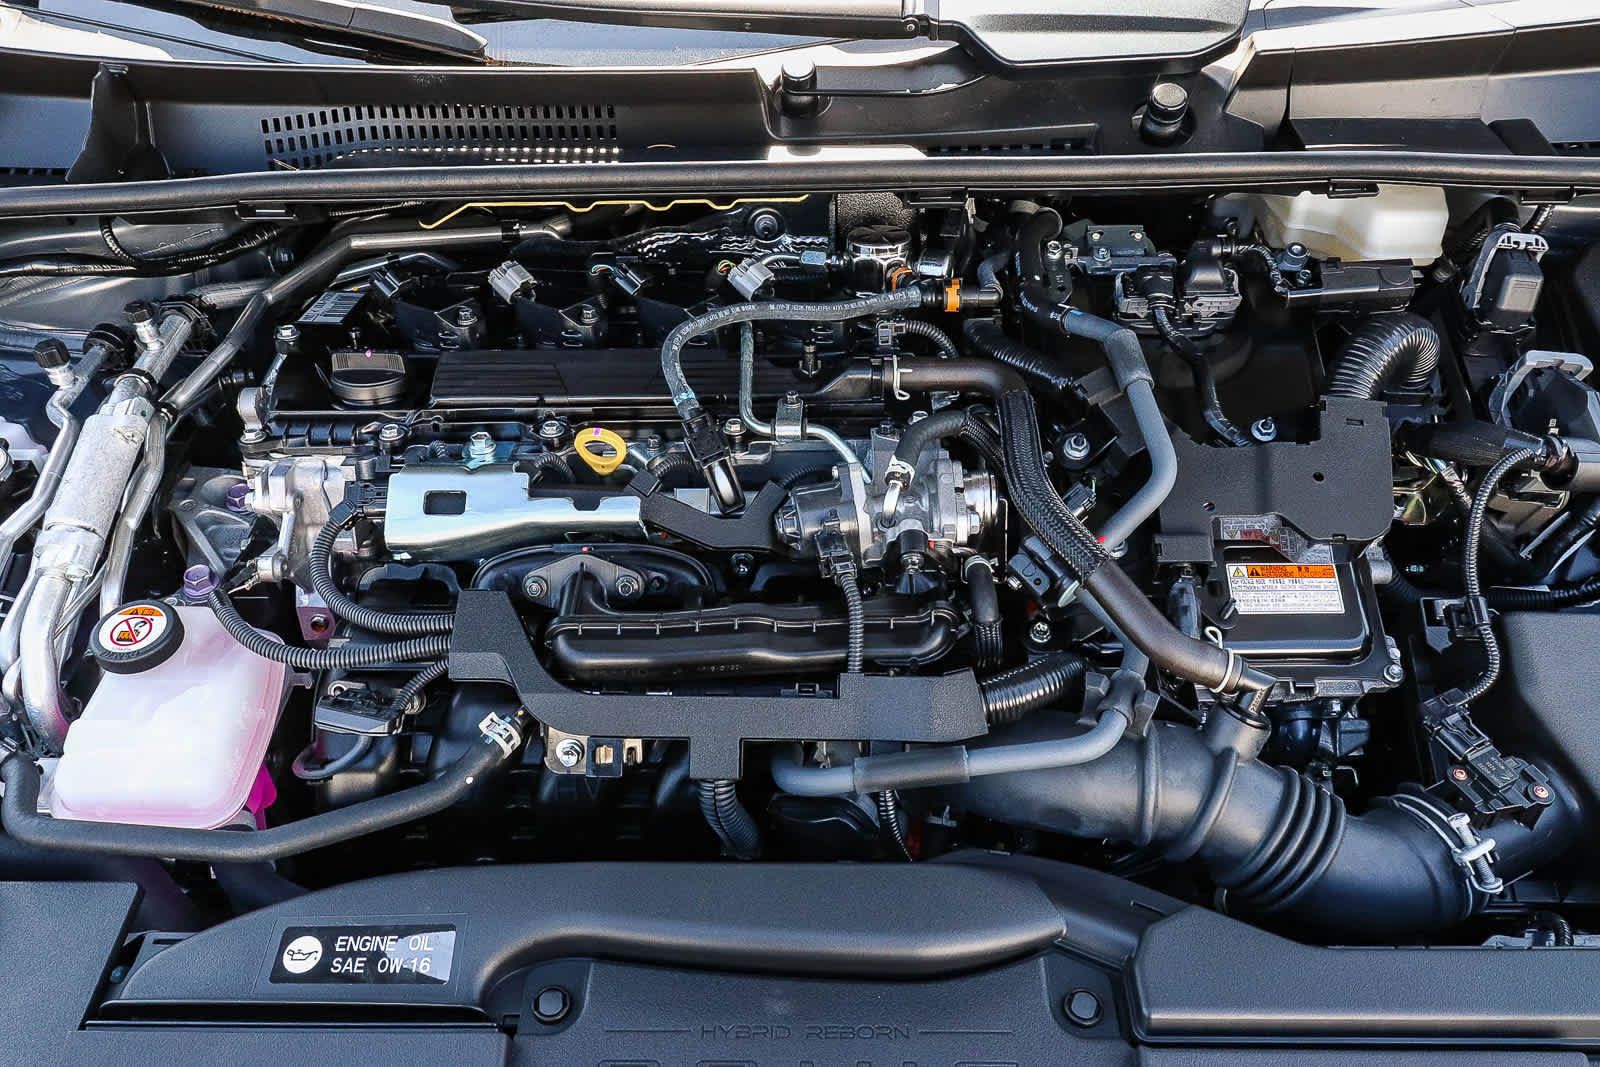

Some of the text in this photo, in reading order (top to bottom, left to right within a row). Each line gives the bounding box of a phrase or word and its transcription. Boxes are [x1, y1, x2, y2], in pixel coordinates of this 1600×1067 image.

[335, 935, 434, 952] ENGINE OIL
[330, 957, 431, 974] SAE 0W-16
[701, 1024, 910, 1041] HYBRID REBORN
